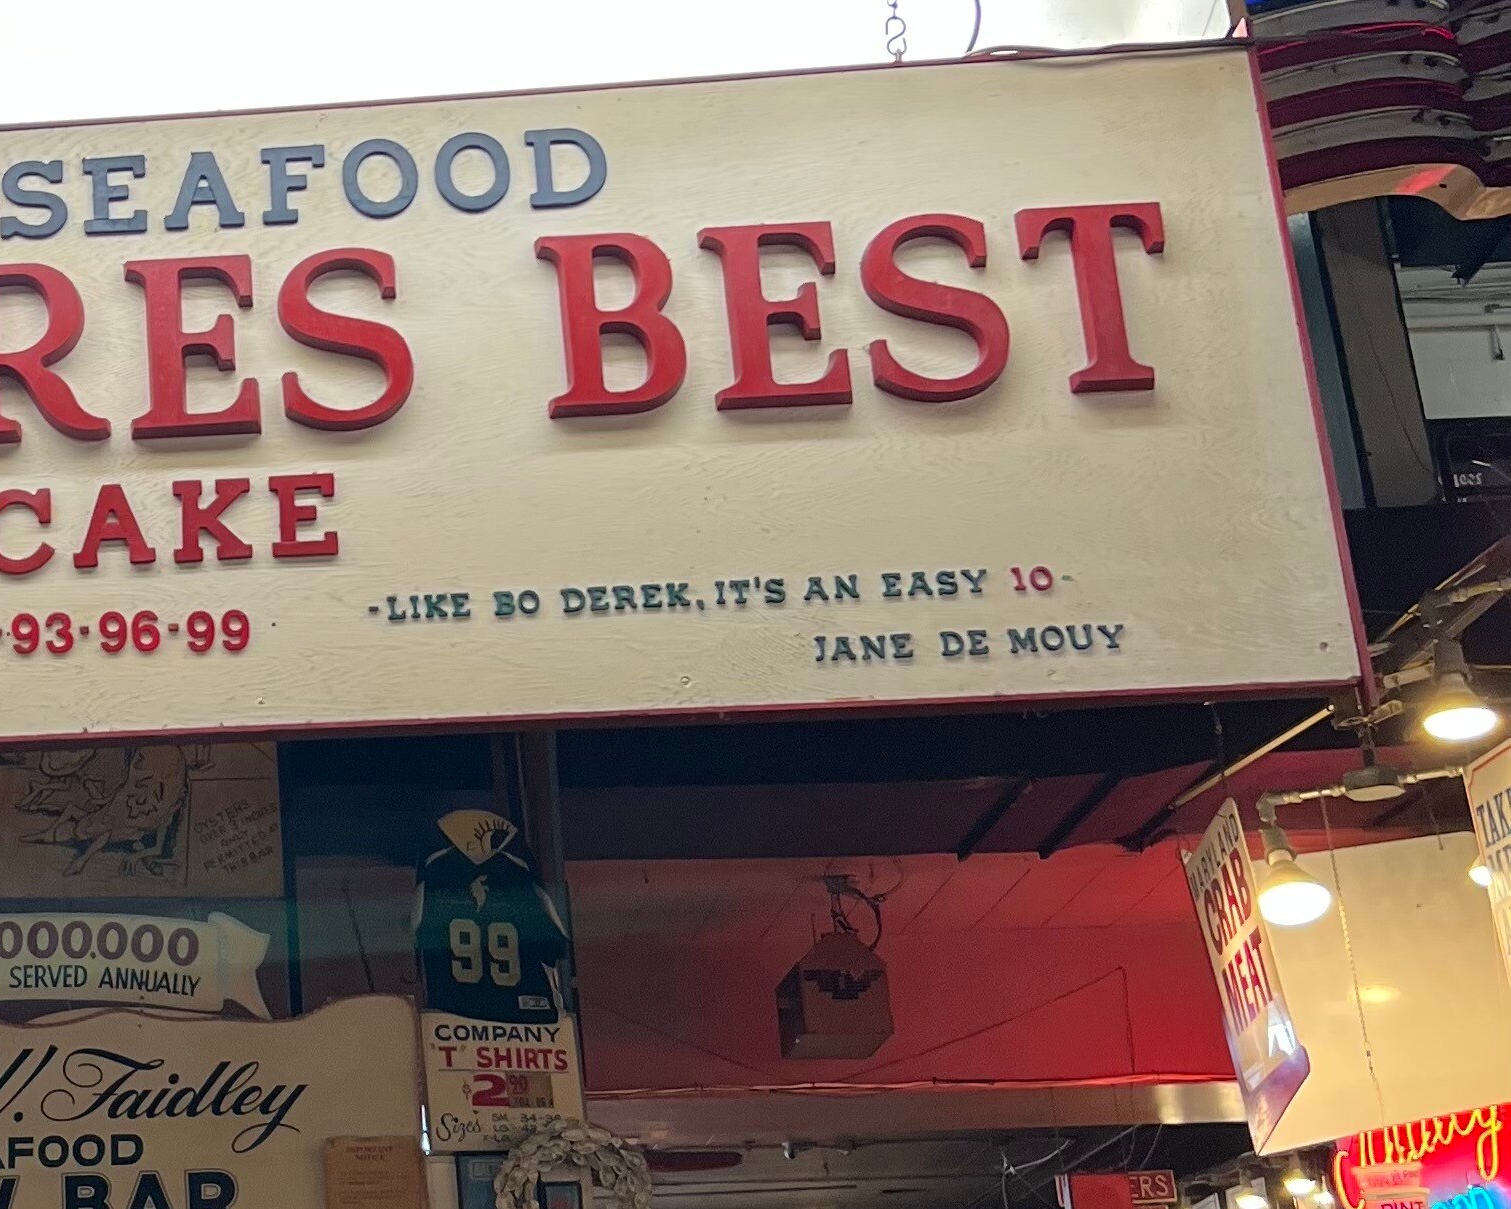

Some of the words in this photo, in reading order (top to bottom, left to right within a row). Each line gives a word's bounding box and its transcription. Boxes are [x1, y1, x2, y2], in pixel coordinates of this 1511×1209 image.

[0, 127, 606, 240] SEAFOOD
[534, 202, 1164, 420] BEST
[493, 590, 541, 616] BO
[803, 574, 860, 601] AN
[881, 568, 987, 598] EASY
[813, 633, 913, 662] JANE
[940, 630, 989, 657] DE
[1007, 624, 1124, 654] MOUY
[1190, 813, 1240, 899] MARYLAND
[1204, 846, 1253, 956] CRAB
[9, 964, 87, 989] SERVED
[98, 967, 201, 998] ANNUALLY
[449, 918, 522, 988] 99
[1222, 925, 1273, 1037] MEAT
[435, 1024, 561, 1044] COMPANY
[476, 1046, 569, 1072] SHIRTS
[41, 1047, 308, 1154] Faidley
